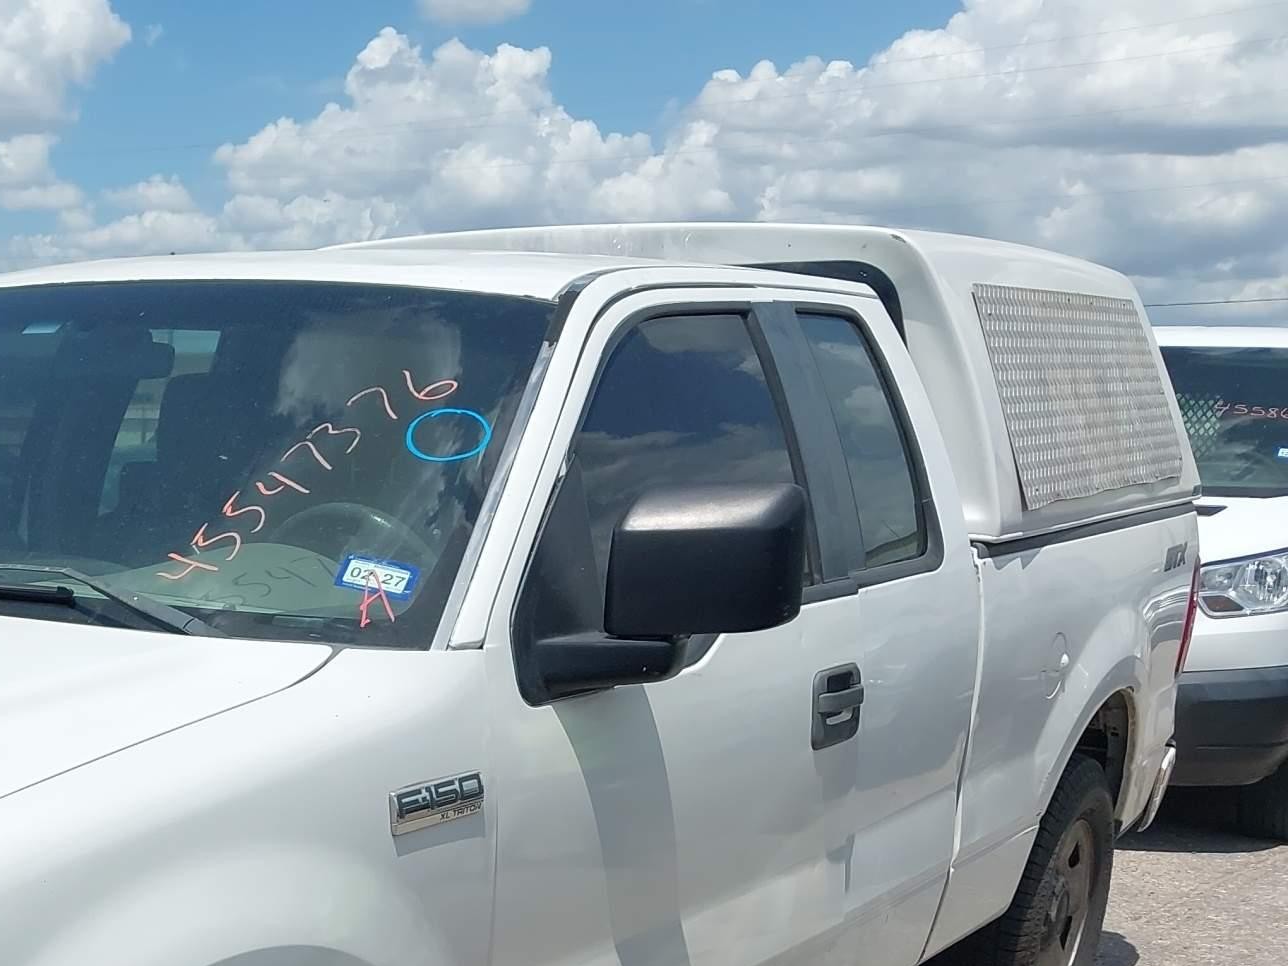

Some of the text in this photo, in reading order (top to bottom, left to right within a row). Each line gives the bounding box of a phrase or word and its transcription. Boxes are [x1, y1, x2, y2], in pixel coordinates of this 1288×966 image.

[155, 368, 459, 581] 45547376
[359, 568, 396, 628] A
[381, 573, 407, 588] 27
